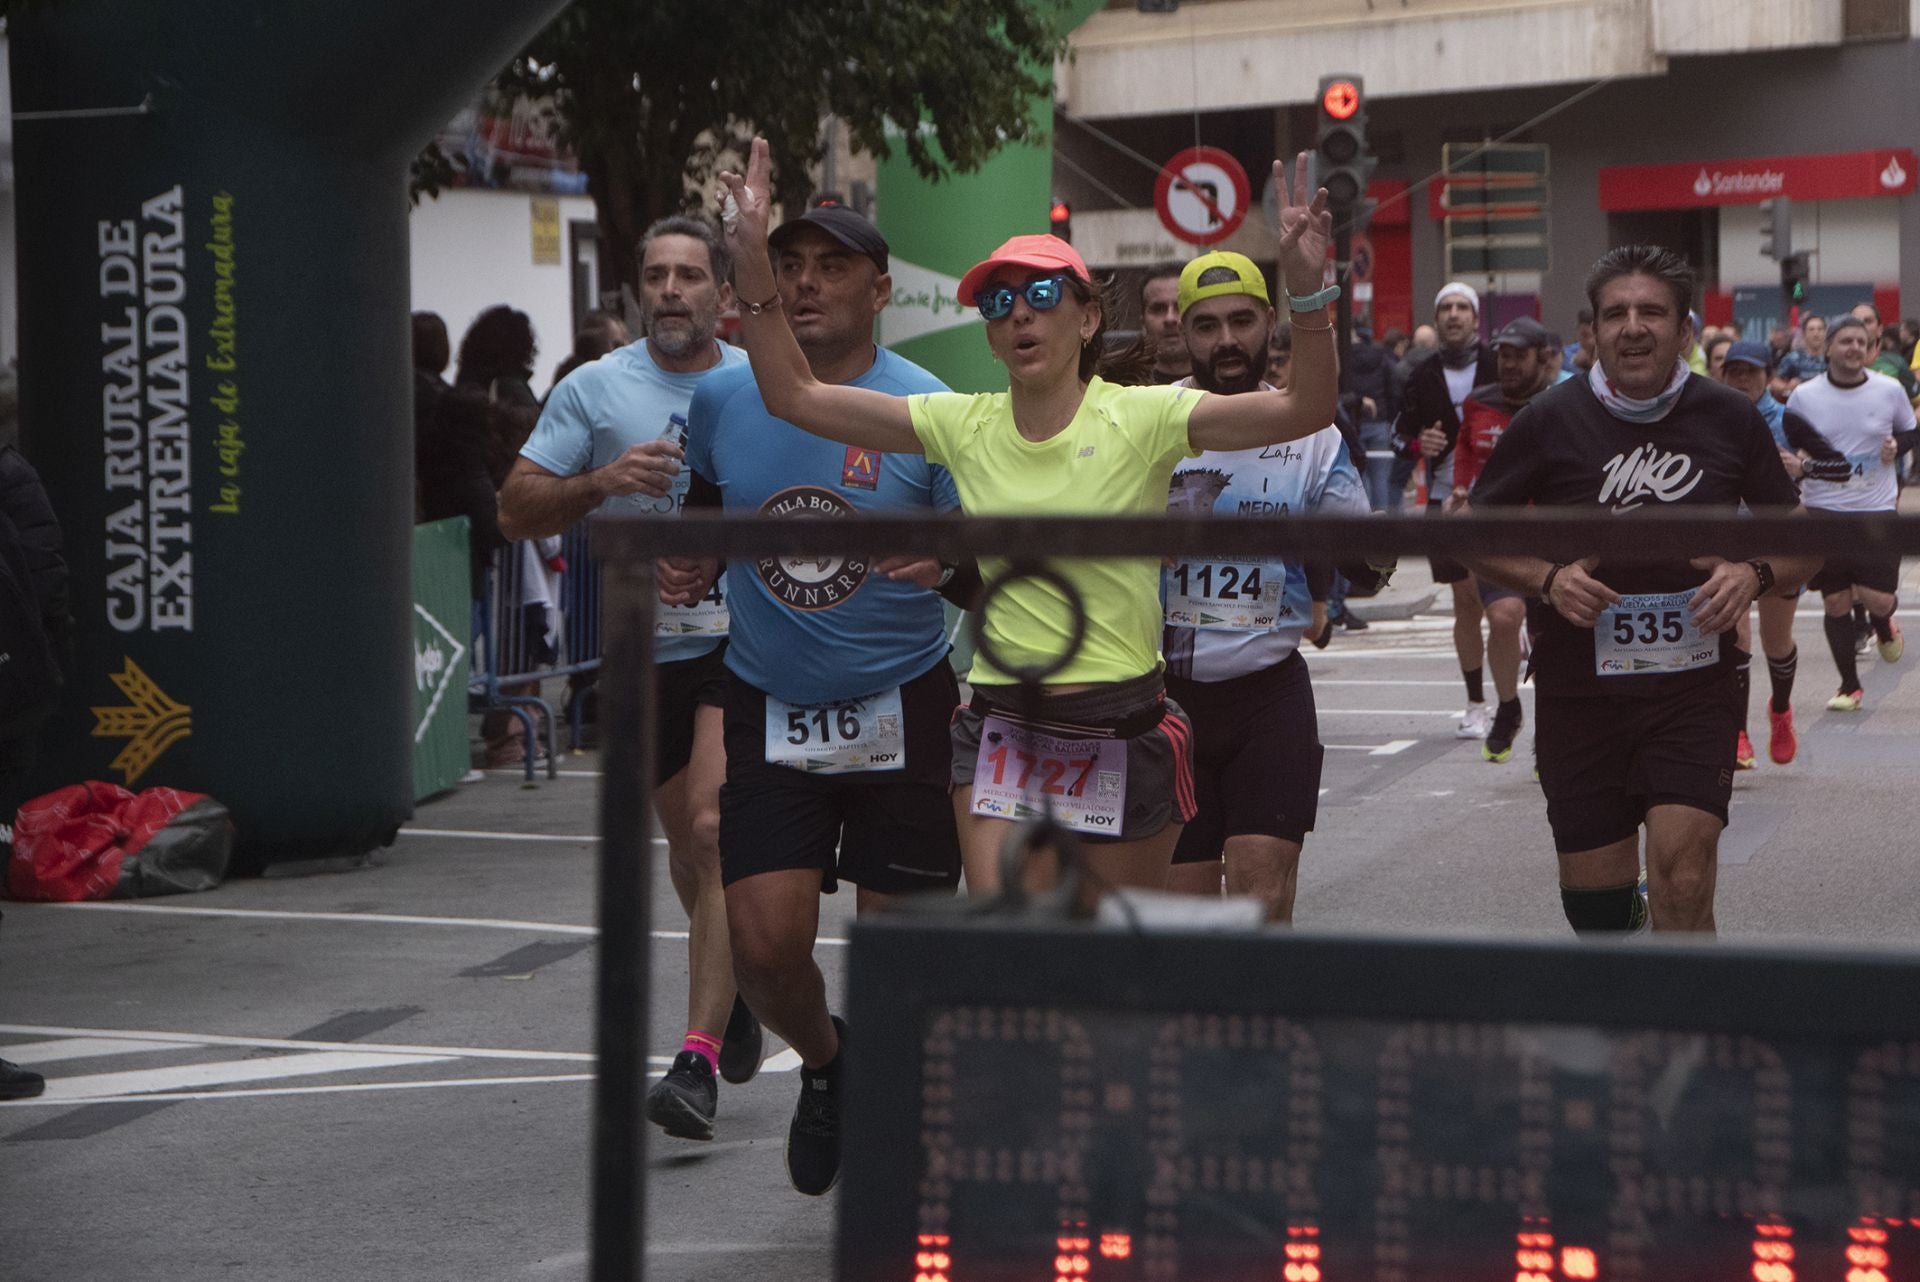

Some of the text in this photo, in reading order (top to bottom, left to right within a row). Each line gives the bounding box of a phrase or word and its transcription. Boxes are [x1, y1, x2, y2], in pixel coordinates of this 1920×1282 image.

[1711, 168, 1785, 196] Santander
[204, 190, 238, 371] Extremadura
[141, 184, 193, 633] EXTREMADURA
[208, 381, 241, 413] de
[97, 219, 149, 633] CAJA RURAL DE
[212, 419, 246, 482] caja
[1598, 442, 1704, 504] Nike
[1237, 500, 1291, 517] MEDIA
[759, 557, 865, 606] RUNNERS
[1173, 563, 1262, 601] 1124
[1254, 616, 1274, 625] HOY
[1613, 611, 1684, 645] 535
[1691, 649, 1714, 662] HOY
[786, 705, 861, 746] 516
[869, 752, 898, 764] HOY
[987, 744, 1096, 798] 1727
[1083, 814, 1116, 827] HOY
